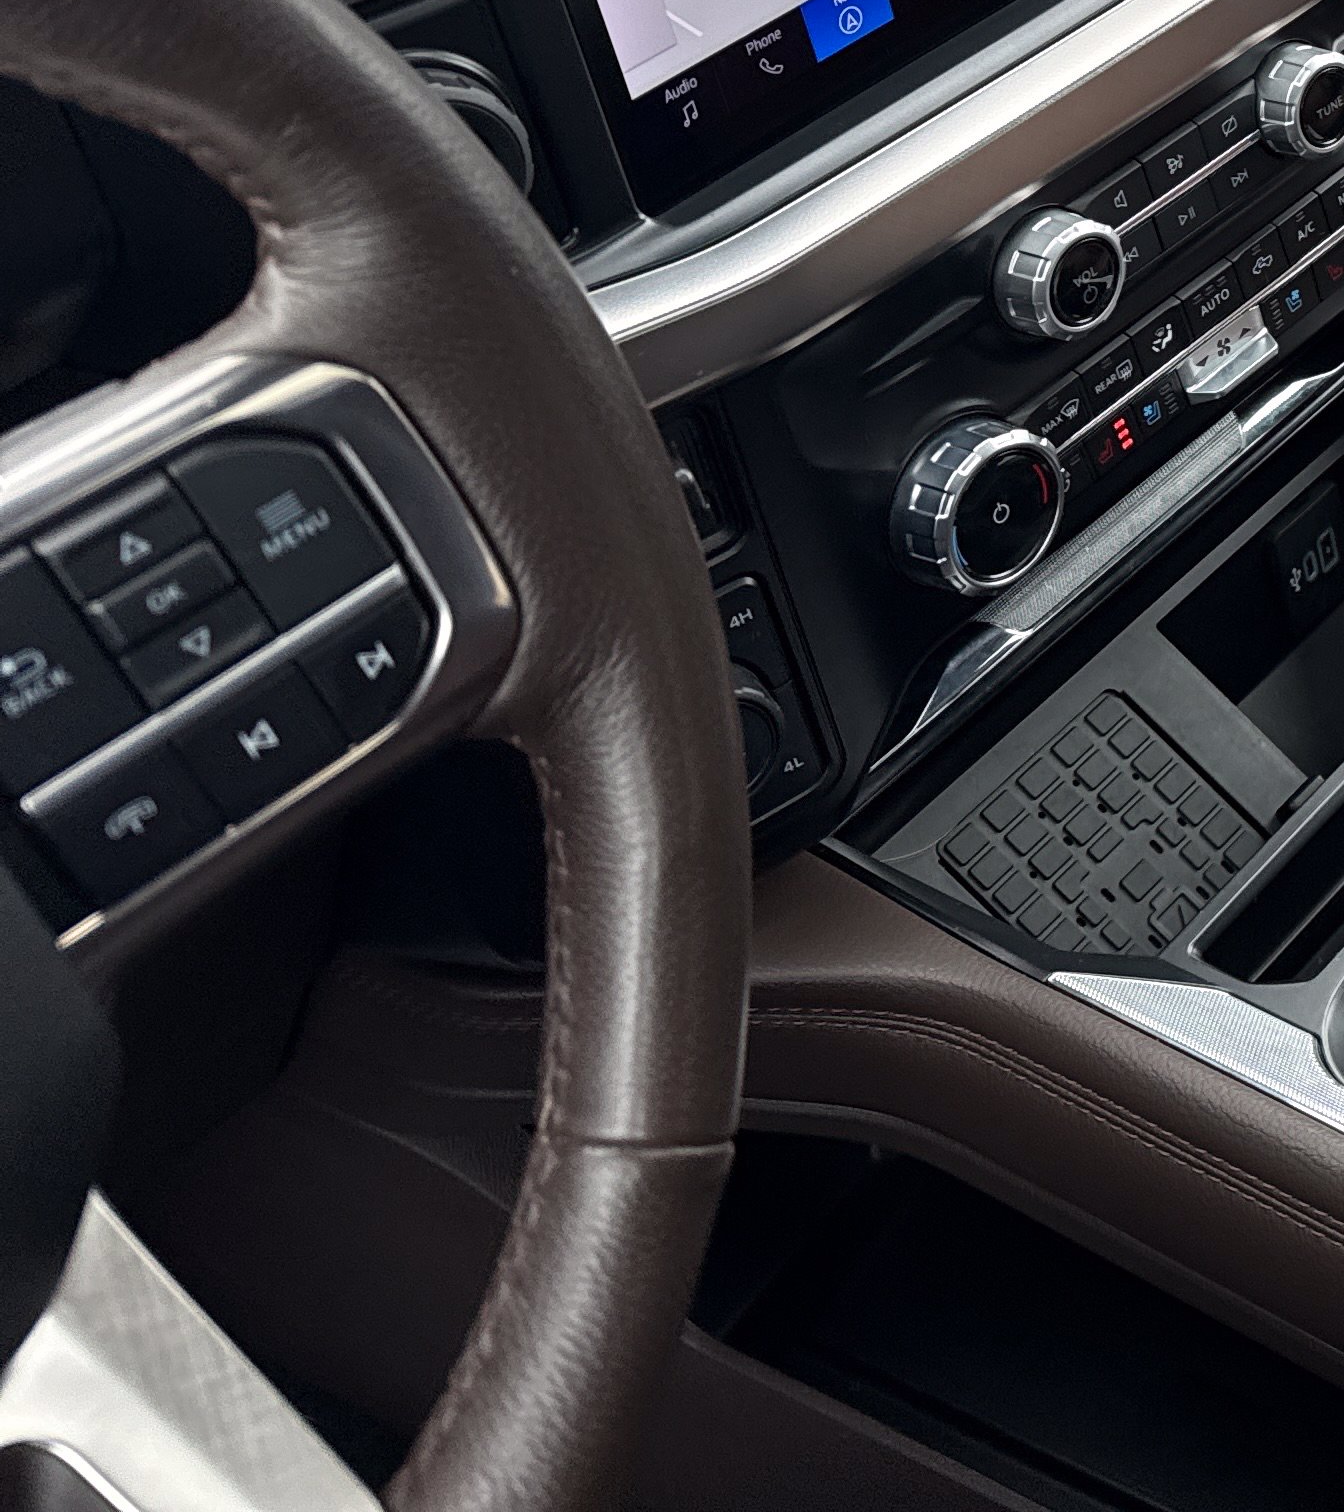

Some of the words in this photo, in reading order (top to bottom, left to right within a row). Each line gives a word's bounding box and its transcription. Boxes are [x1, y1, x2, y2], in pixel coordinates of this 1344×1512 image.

[745, 27, 783, 57] Phone
[664, 75, 699, 104] Audio
[1316, 95, 1344, 120] TUNE
[1298, 221, 1316, 241] A/C
[1072, 266, 1099, 288] VOL
[1201, 288, 1231, 317] AUTO
[1095, 374, 1117, 394] REAR
[1041, 415, 1064, 435] MAX
[260, 506, 331, 561] MENU
[146, 582, 188, 615] OK
[729, 608, 754, 631] 4H
[783, 754, 806, 775] 4L
